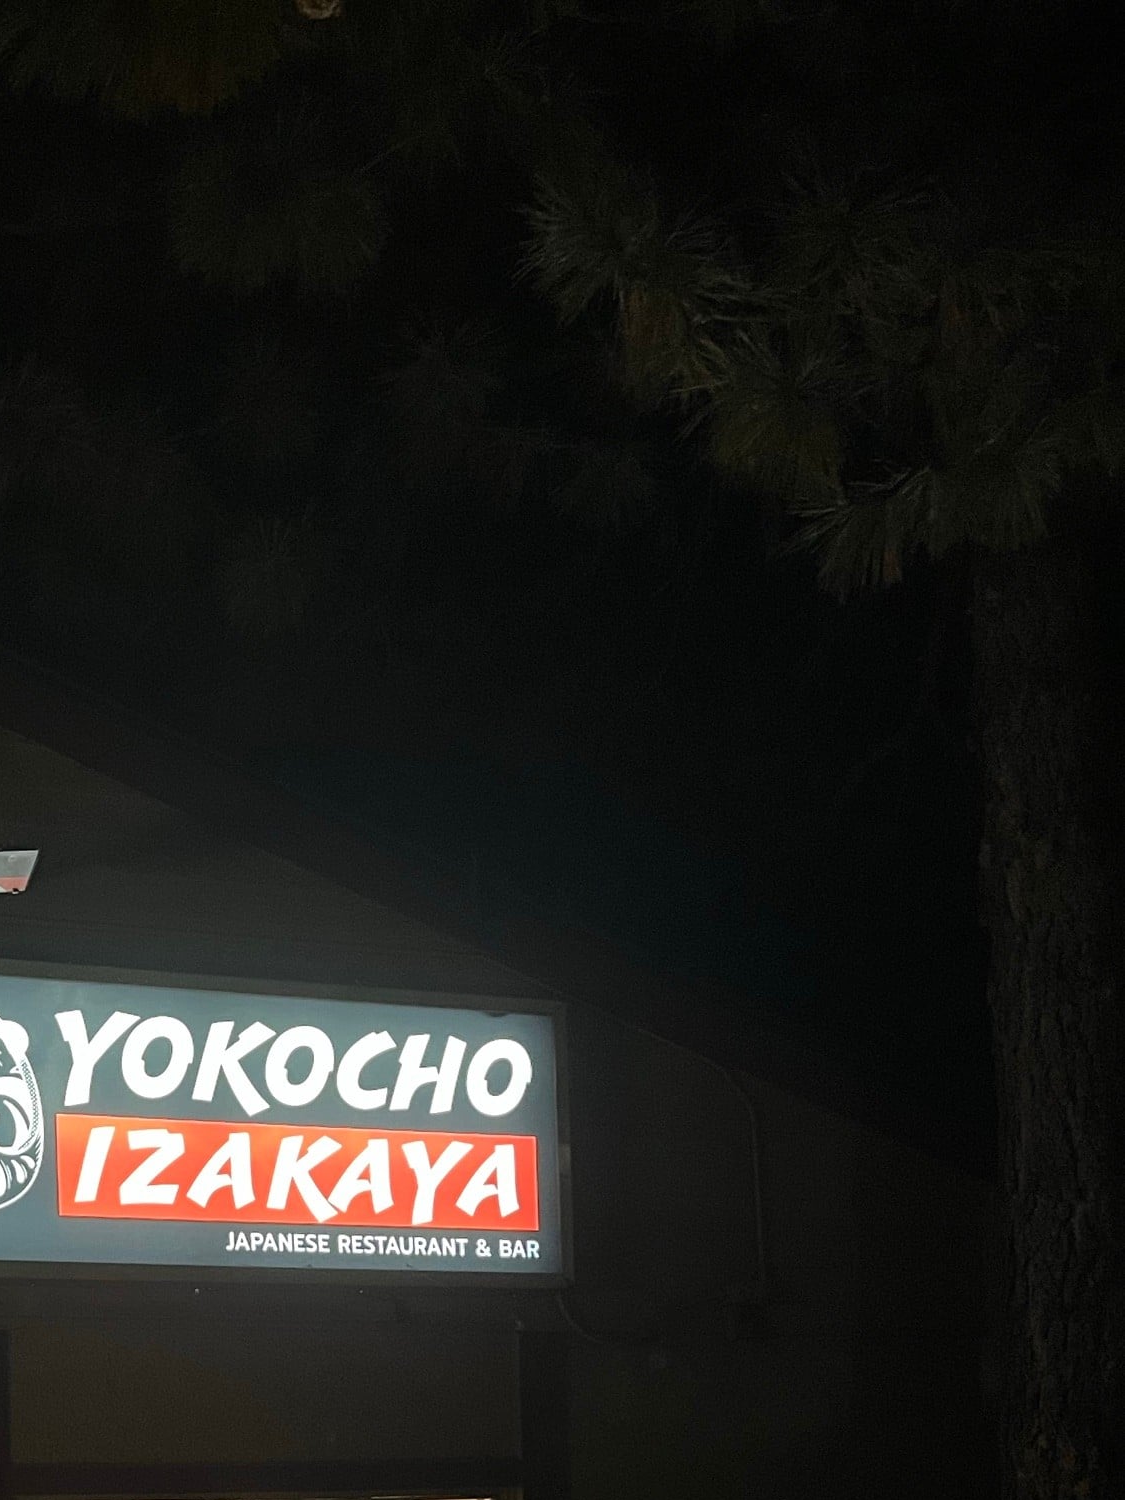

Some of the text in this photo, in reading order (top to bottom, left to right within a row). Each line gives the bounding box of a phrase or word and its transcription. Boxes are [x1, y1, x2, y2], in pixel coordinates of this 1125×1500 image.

[54, 1010, 533, 1117] YOKOCHO
[74, 1126, 521, 1225] IZAKAYA
[225, 1231, 540, 1259] JAPANESE RESTAURANT & BAR
